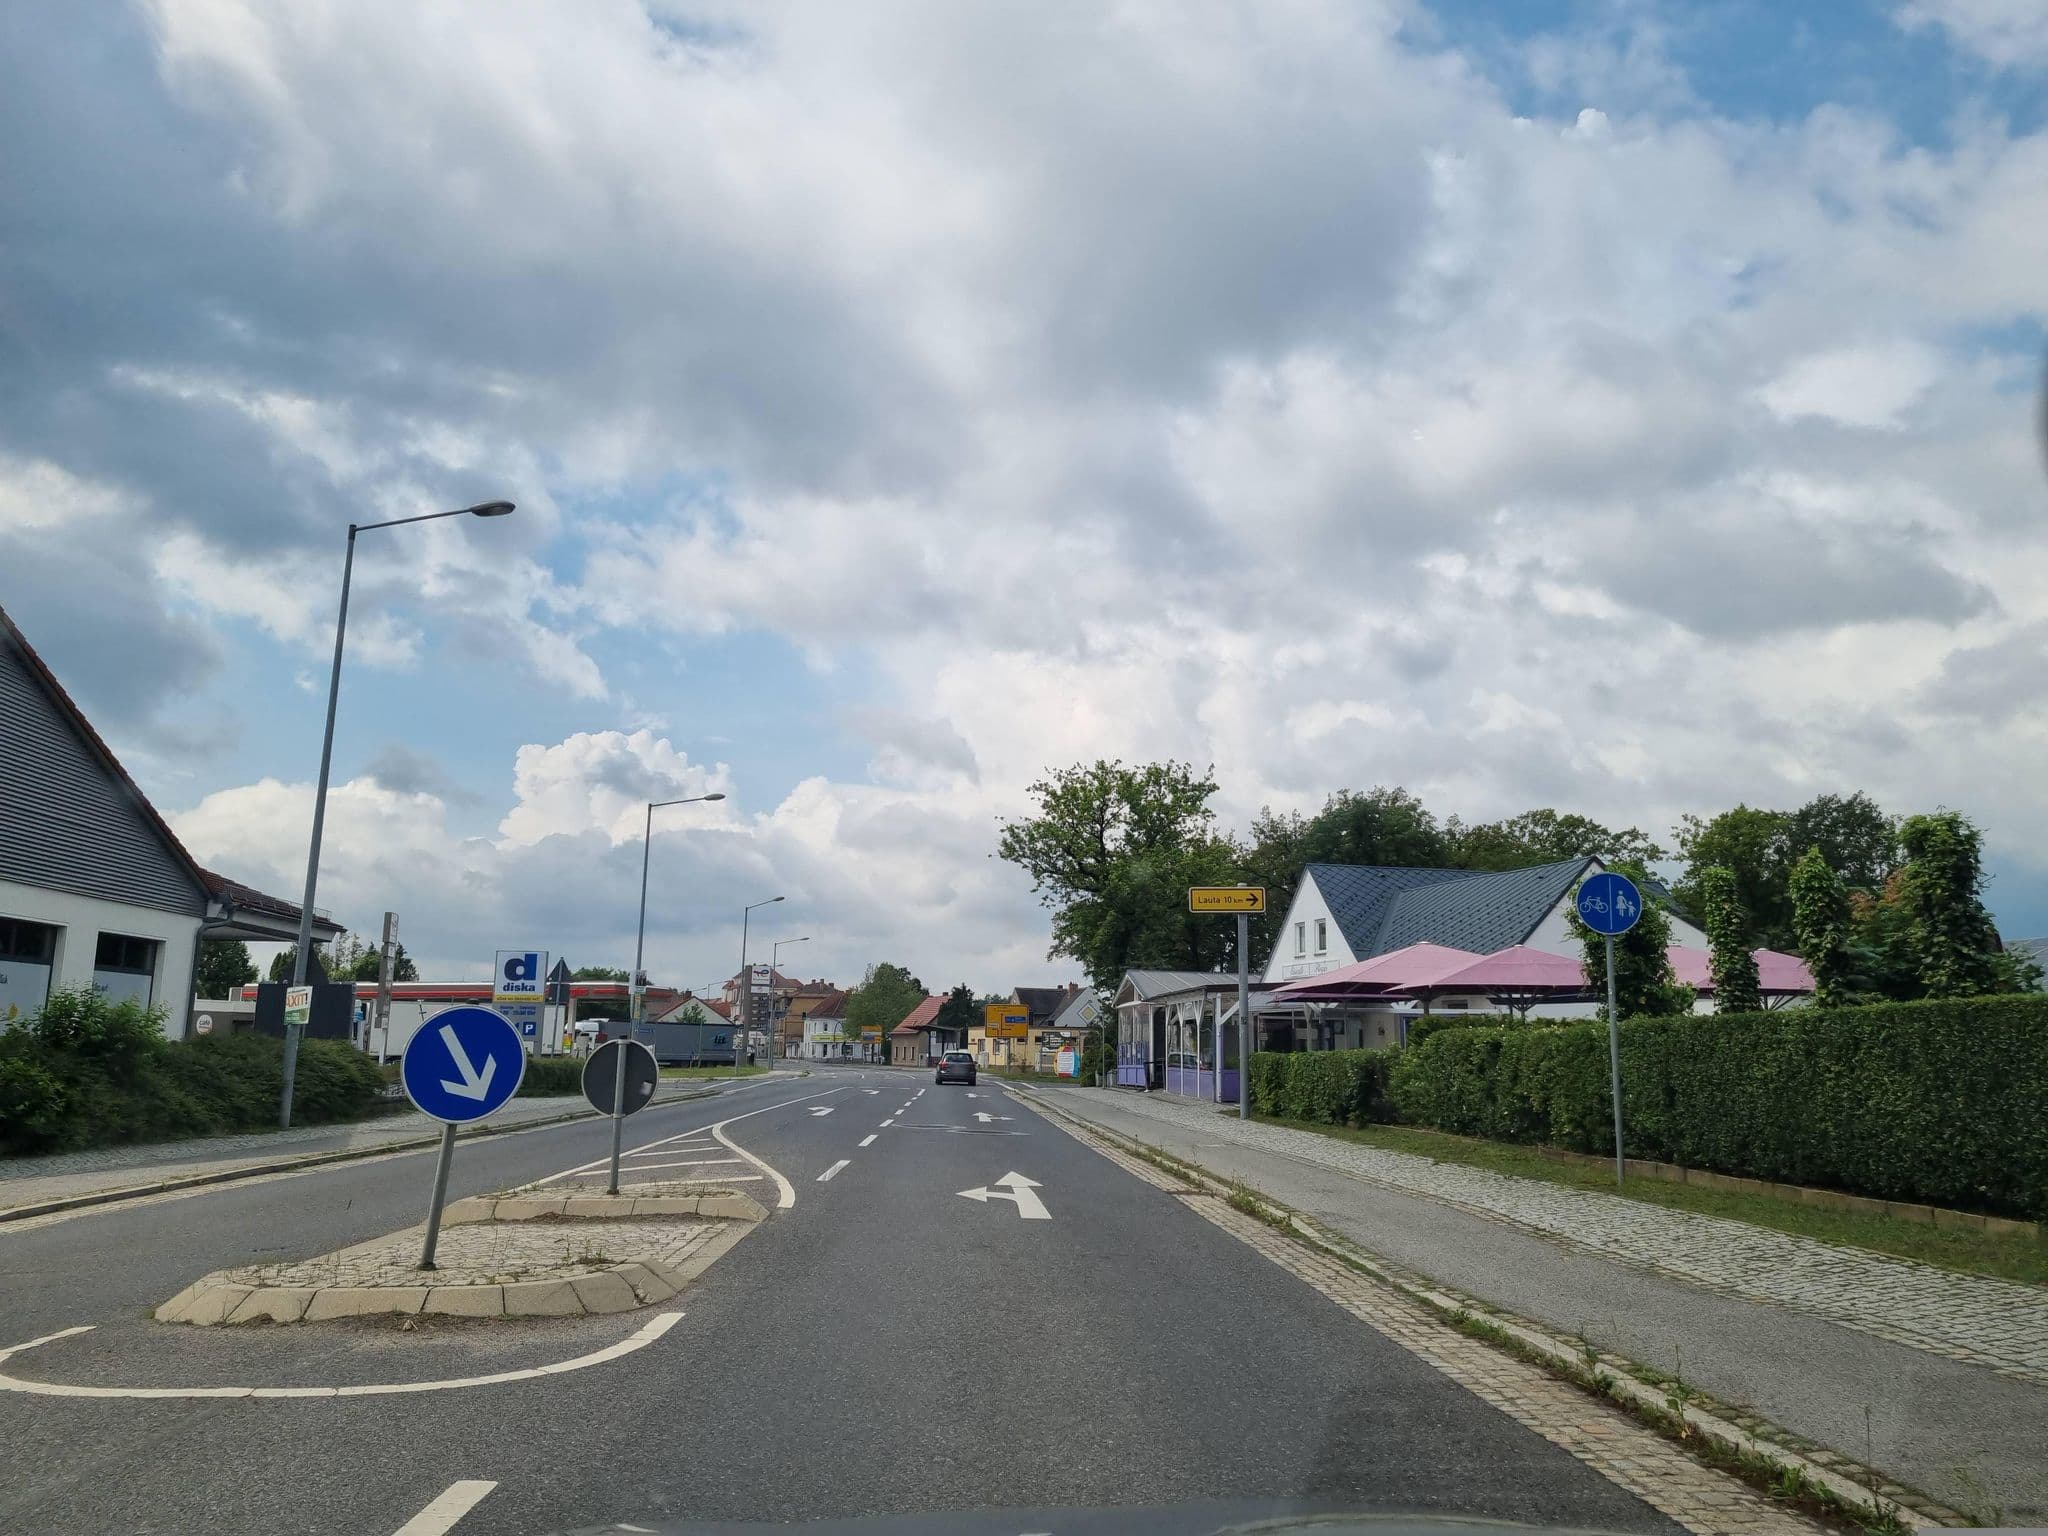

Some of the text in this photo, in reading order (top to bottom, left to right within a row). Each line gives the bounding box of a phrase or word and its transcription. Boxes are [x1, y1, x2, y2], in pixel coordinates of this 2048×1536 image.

[1198, 896, 1221, 904] Lauta
[1223, 895, 1232, 904] 10
[504, 953, 538, 981] d
[502, 982, 536, 992] diska
[525, 1024, 533, 1033] P
